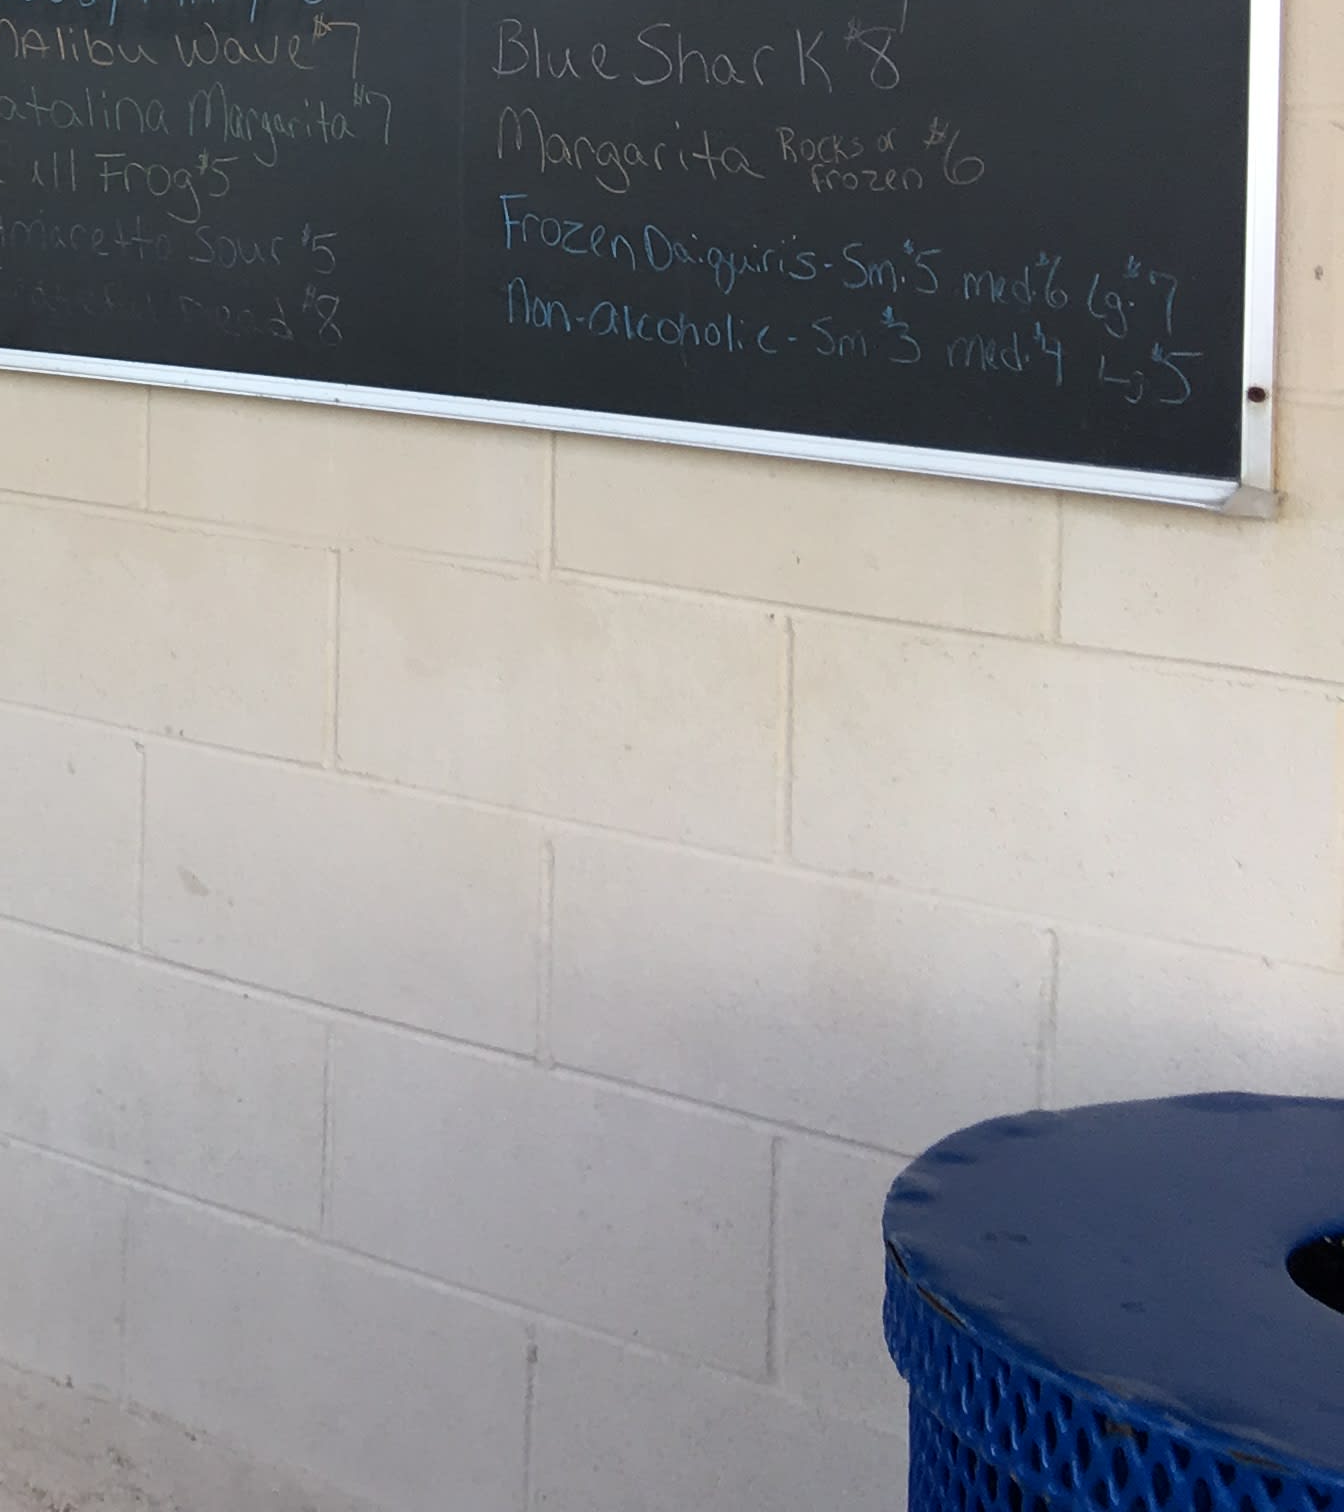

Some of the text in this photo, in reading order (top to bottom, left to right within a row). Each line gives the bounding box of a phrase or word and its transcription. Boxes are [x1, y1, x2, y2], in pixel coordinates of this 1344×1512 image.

[175, 21, 314, 71] Wave
[492, 18, 621, 81] Blue
[496, 106, 765, 194] Margarita
[775, 126, 866, 166] Rocks
[923, 116, 986, 186] $6
[186, 224, 286, 271] Sour
[499, 194, 636, 271] Frozen
